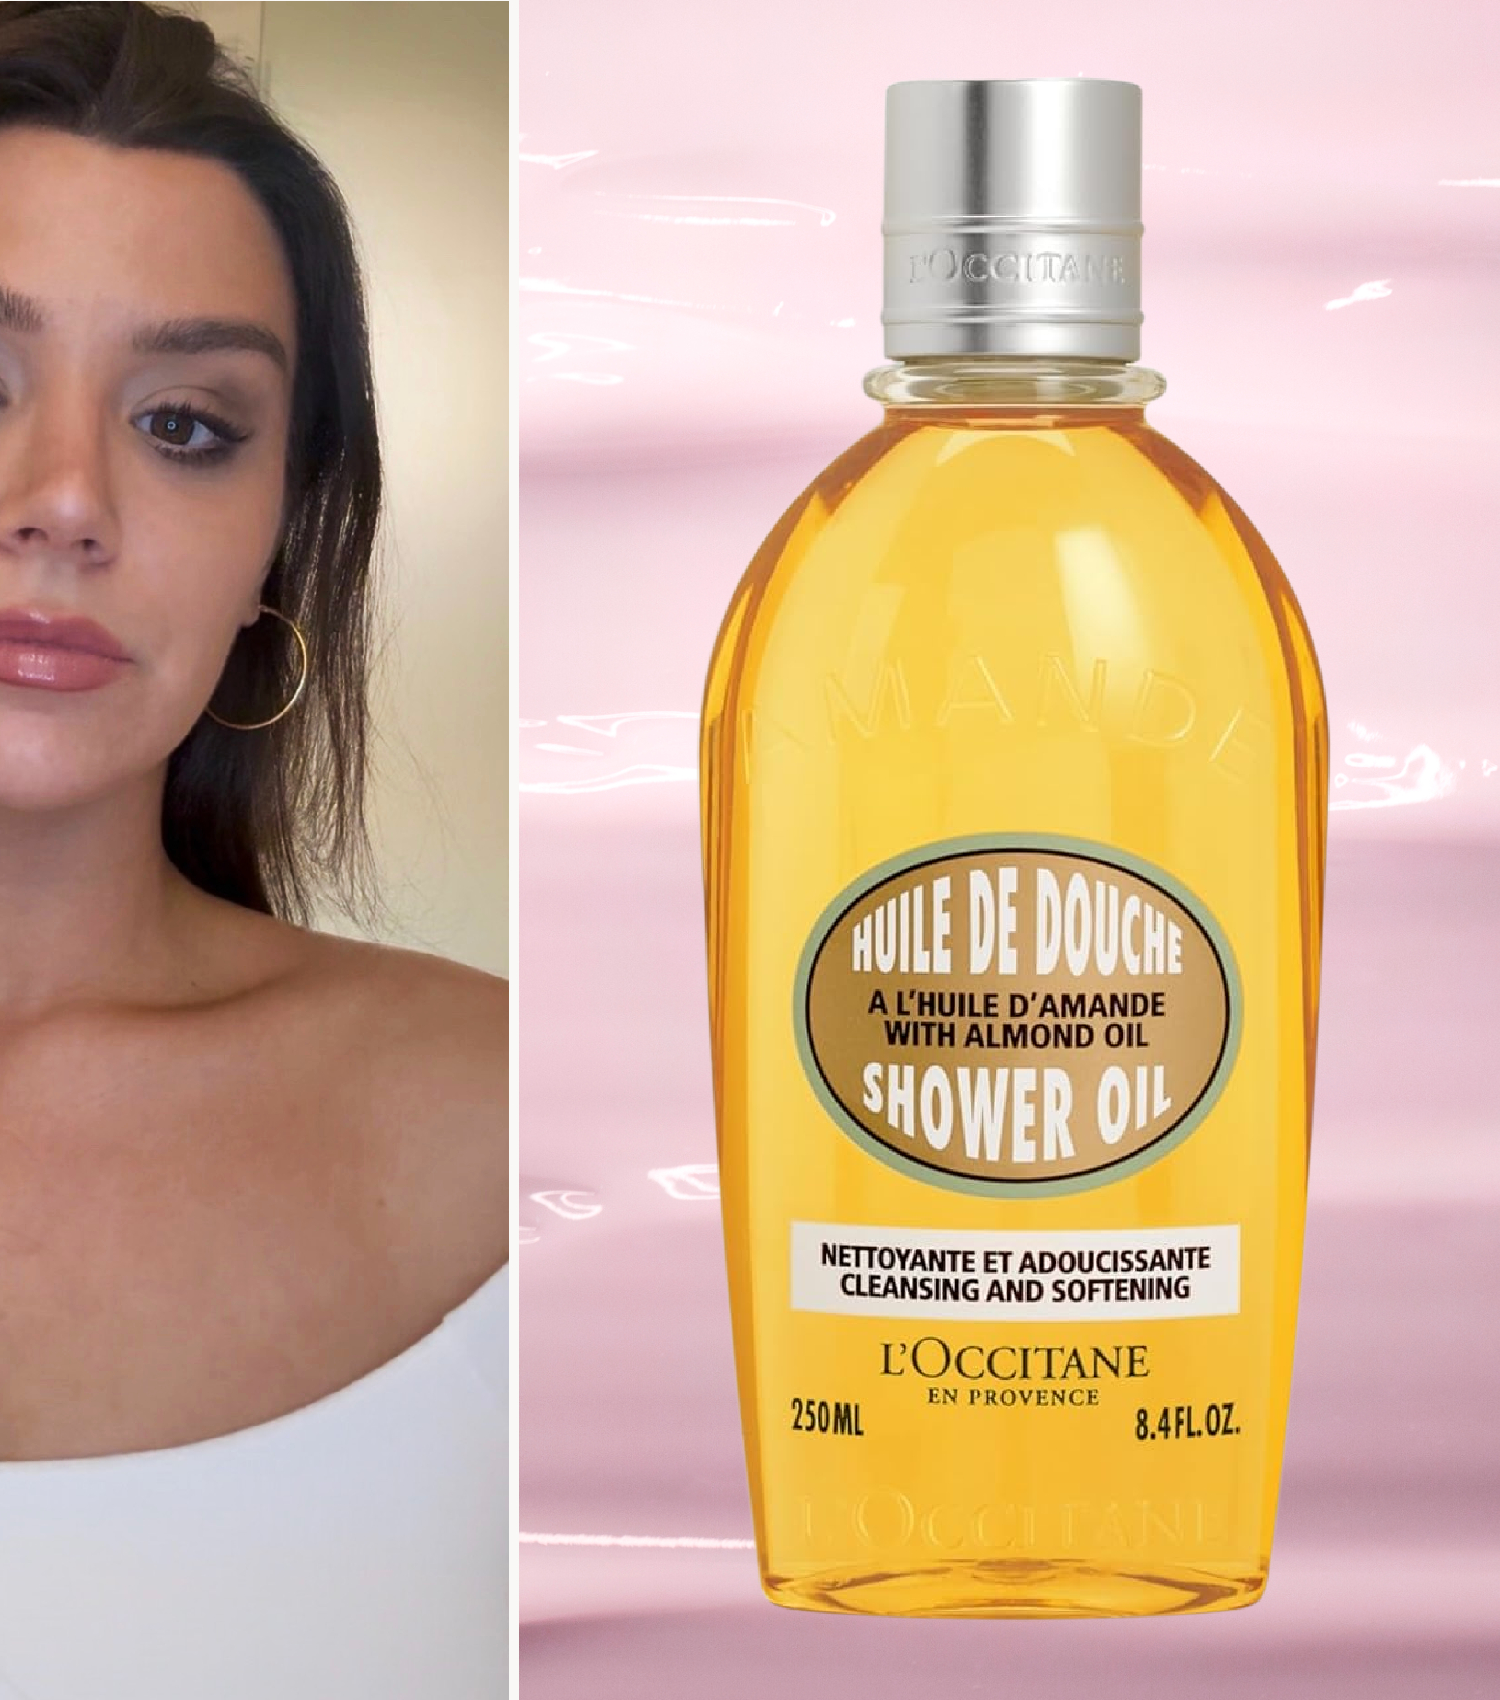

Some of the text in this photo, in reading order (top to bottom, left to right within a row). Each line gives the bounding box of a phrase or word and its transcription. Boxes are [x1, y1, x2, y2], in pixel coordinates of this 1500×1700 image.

[741, 650, 1271, 784] AMANDE
[852, 867, 1183, 976] HUILE DE DOUCHE
[867, 988, 1166, 1018] A L'HUILE D'AMANDE
[883, 1019, 1149, 1049] WITH ALMOND OIL
[863, 1062, 1172, 1163] SHOWER OIL
[821, 1242, 1212, 1274] NETTOYANTE ET ADOUCISSANTE
[840, 1273, 1191, 1303] CLEANSING AND SOFTENING
[881, 1336, 1151, 1381] L'OCCITANE
[928, 1387, 1100, 1407] EN PROVENCE
